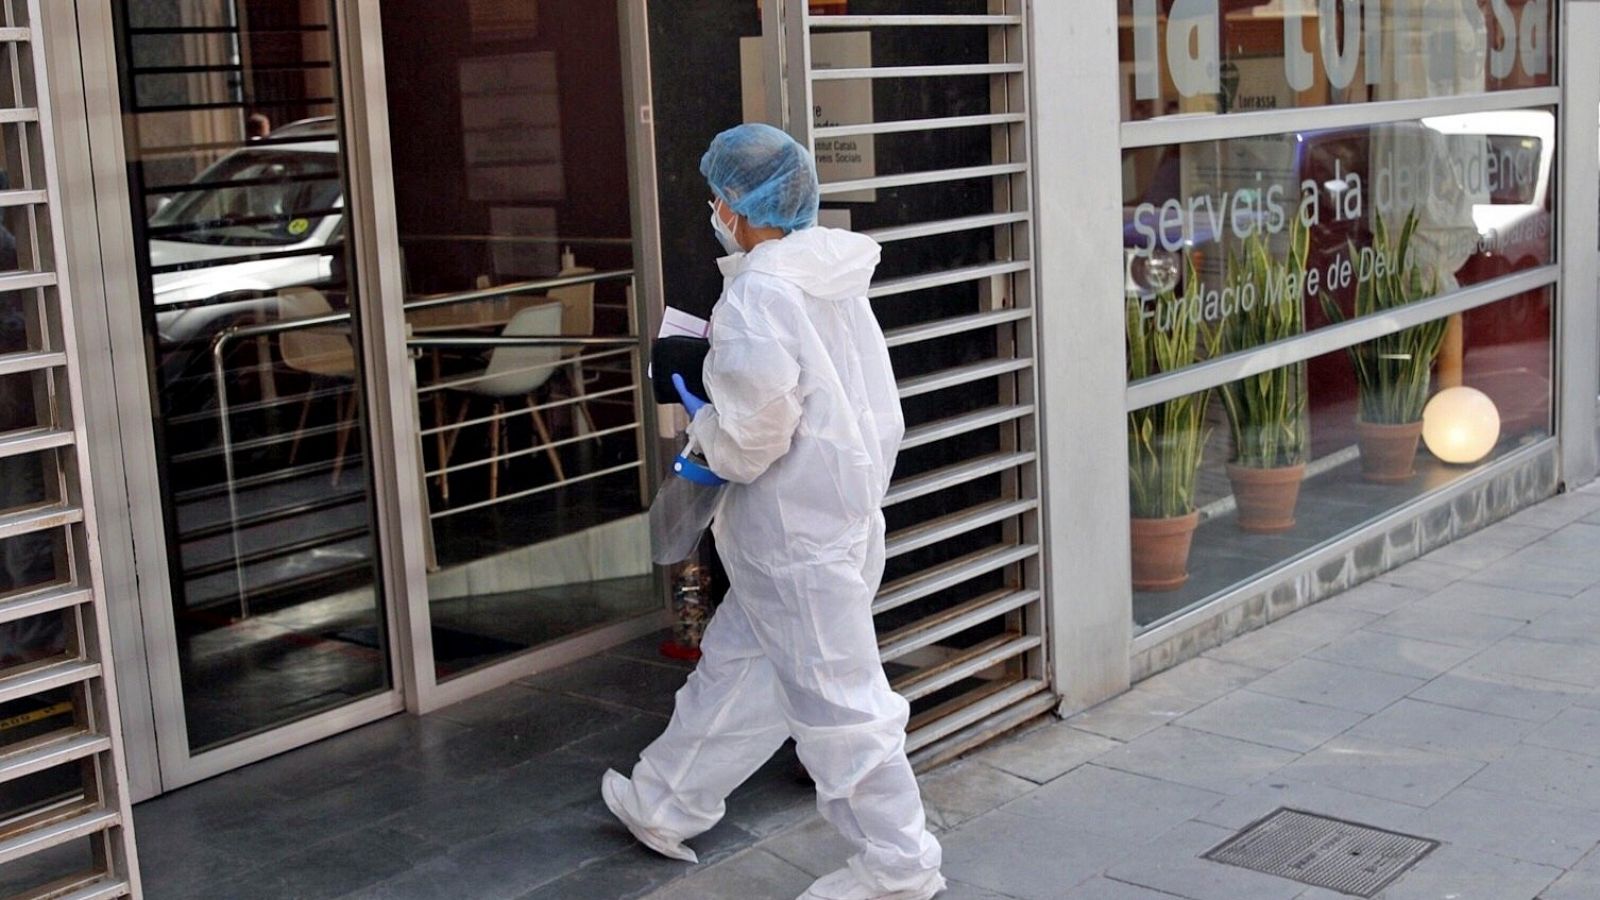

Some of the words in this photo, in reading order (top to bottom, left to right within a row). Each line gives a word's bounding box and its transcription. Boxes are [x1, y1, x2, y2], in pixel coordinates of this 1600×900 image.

[1134, 171, 1285, 257] serveis
[1301, 178, 1319, 228] a
[1335, 158, 1362, 221] la
[1140, 273, 1255, 335] Fundació
[1264, 266, 1319, 308] Mare
[1327, 253, 1352, 290] de
